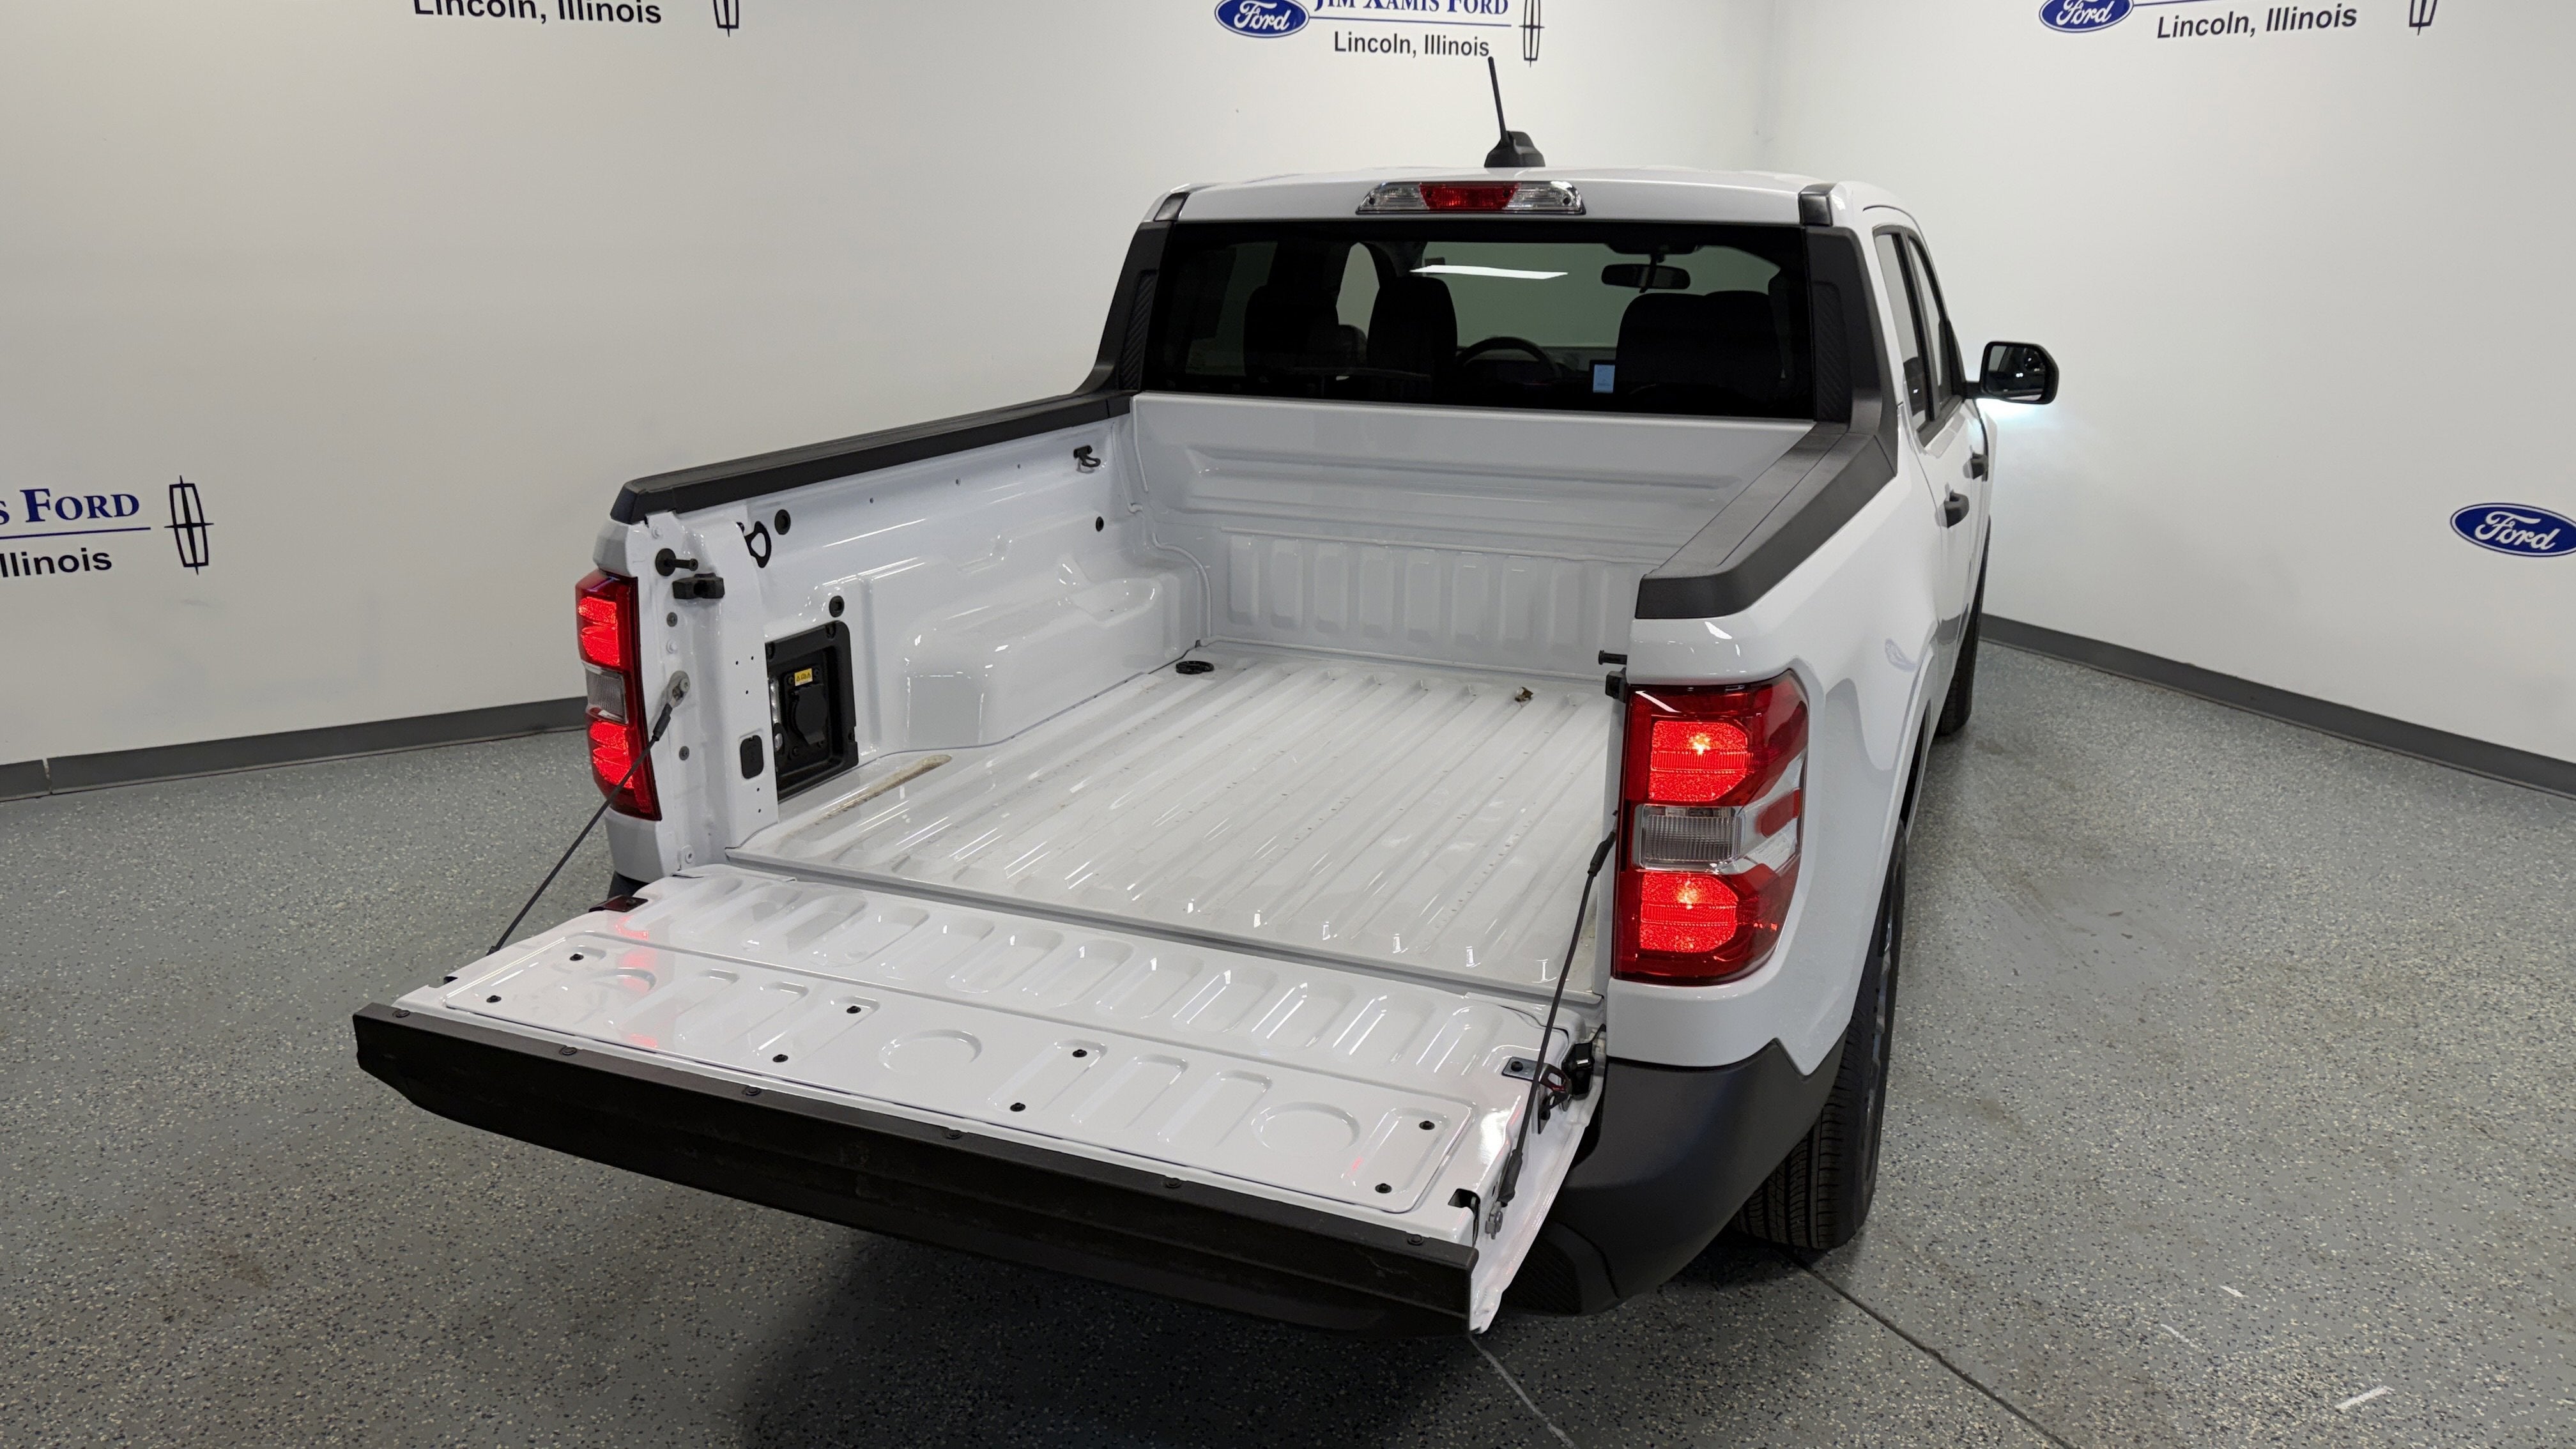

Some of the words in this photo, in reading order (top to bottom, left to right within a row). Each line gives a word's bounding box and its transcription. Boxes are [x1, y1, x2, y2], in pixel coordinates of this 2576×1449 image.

[414, 0, 547, 24] Lincoln,
[558, 0, 662, 24] Illinois
[1233, 0, 1292, 31] Ford
[1363, 0, 1440, 12] MIS
[2055, 0, 2115, 26] Ford
[2157, 10, 2256, 38] Lincoln,
[2266, 3, 2358, 31] Illinois
[1334, 31, 1416, 58] Lincoln,
[1425, 34, 1489, 56] Illinois
[19, 488, 139, 523] FORD
[2474, 511, 2561, 550] Ford
[0, 548, 112, 578] llinois
